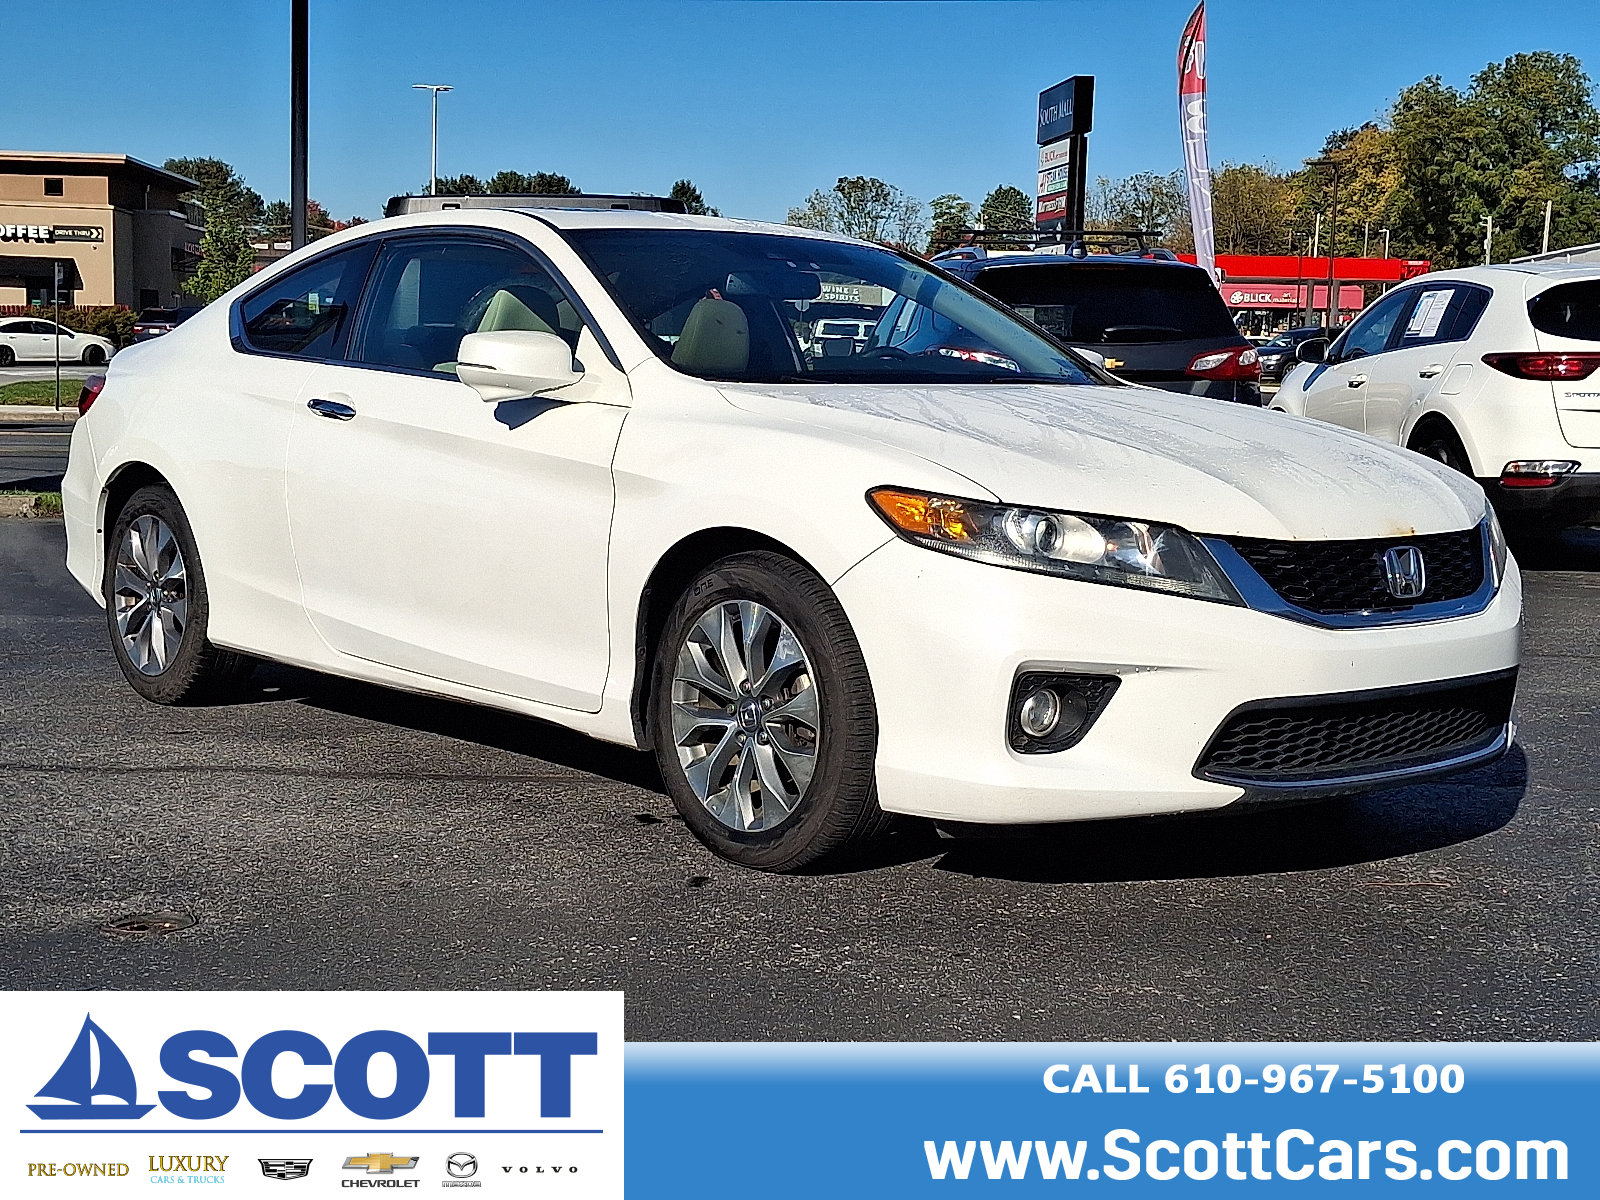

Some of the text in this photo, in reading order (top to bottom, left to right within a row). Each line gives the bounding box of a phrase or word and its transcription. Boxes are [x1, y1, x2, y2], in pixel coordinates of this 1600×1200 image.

[1040, 98, 1072, 127] SOUTH MALL
[822, 285, 849, 294] WINE
[1243, 293, 1272, 303] BLICK
